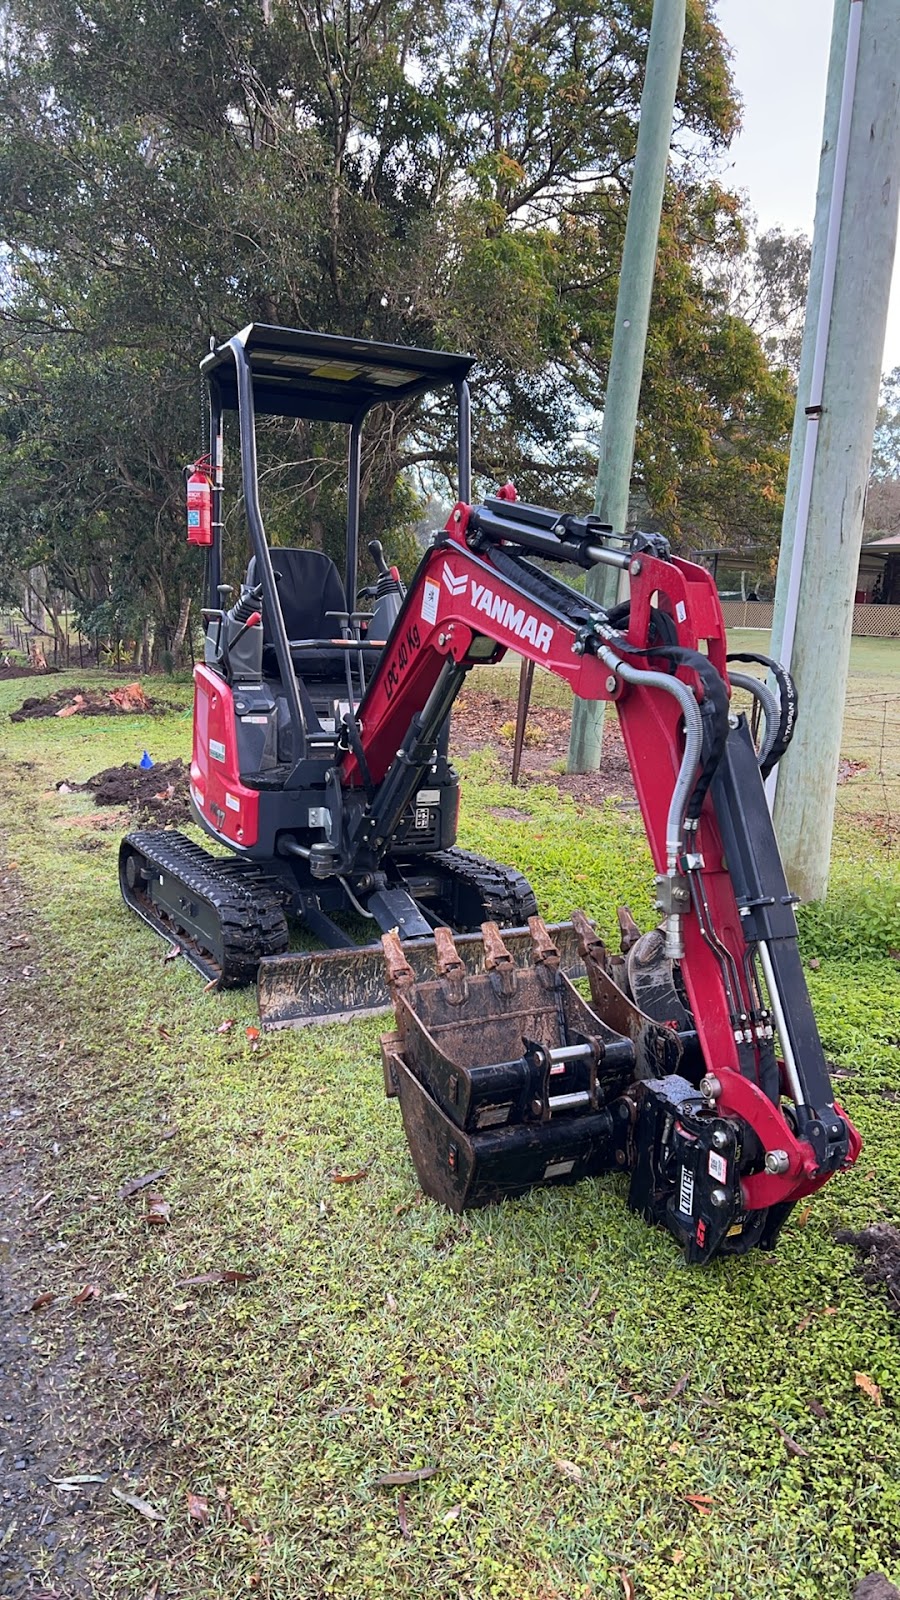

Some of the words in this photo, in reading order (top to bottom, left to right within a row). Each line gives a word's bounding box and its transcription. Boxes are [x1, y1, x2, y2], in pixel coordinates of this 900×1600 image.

[470, 580, 554, 654] YANMAR
[384, 661, 399, 701] LPC
[398, 642, 408, 671] 40
[406, 623, 421, 654] Kg
[785, 702, 795, 735] TAIPAN
